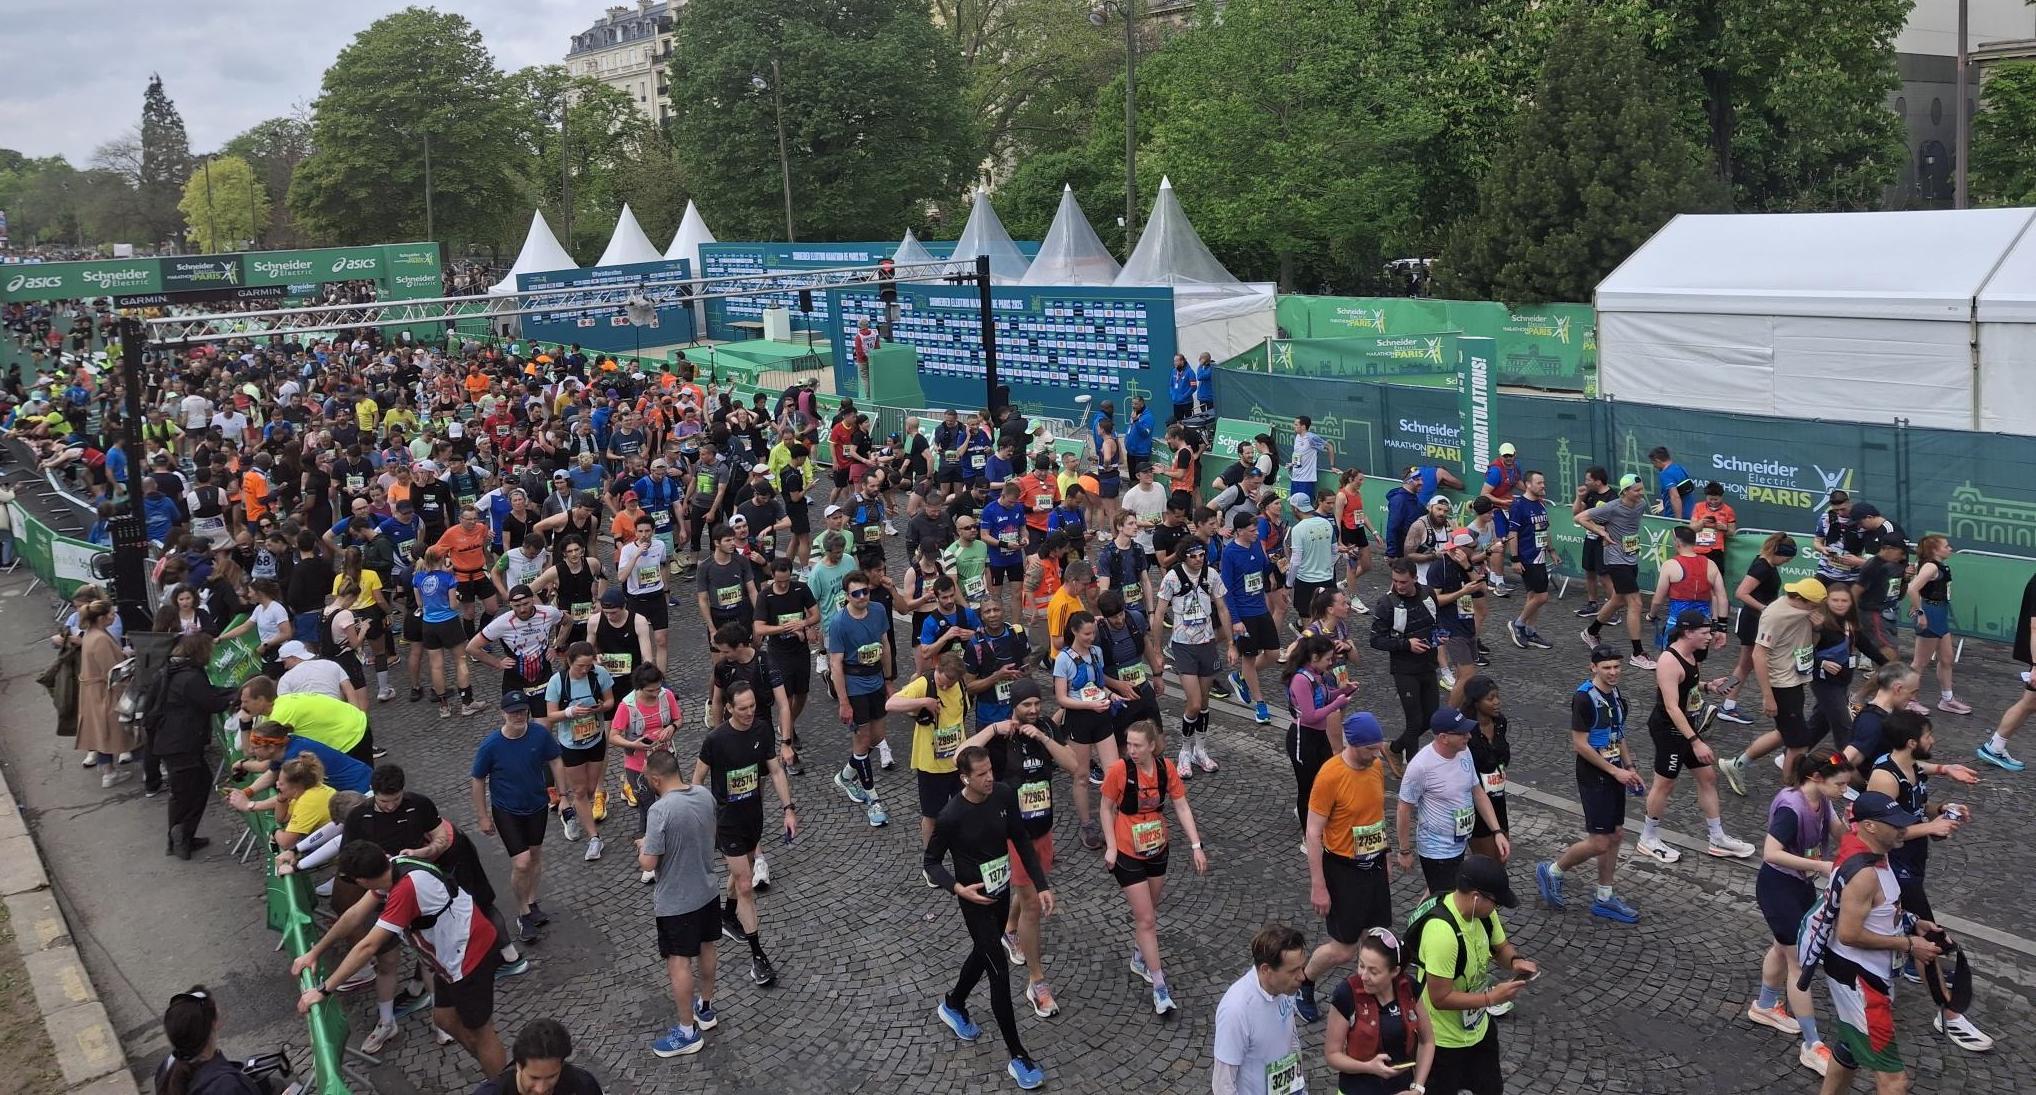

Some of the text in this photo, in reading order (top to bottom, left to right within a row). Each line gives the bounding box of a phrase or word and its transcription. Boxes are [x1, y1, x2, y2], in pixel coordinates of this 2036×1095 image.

[176, 263, 215, 271] Schneider
[254, 260, 313, 274] Schneider
[346, 258, 376, 270] asics
[82, 269, 149, 282] Schneider
[25, 276, 62, 289] asics
[237, 288, 281, 297] GARMIN
[120, 295, 167, 306] GARMIN
[1350, 319, 1372, 328] PARIS
[1528, 327, 1552, 336] PARIS
[1376, 339, 1417, 347] Schneider
[1394, 350, 1424, 359] PARIS
[1471, 356, 1489, 473] CONGRATULATIONS!
[1400, 419, 1460, 437] Schneider
[1384, 438, 1426, 452] MARATHON
[1425, 434, 1459, 446] Electric
[1426, 444, 1460, 462] PARI
[1712, 453, 1799, 478] Schneider
[1748, 473, 1797, 488] Electric
[1739, 486, 1812, 508] DE PARIS
[257, 556, 270, 566] 68
[1781, 566, 1817, 576] MARATH
[732, 775, 754, 788] 32574
[1025, 789, 1046, 804] 72963
[1359, 833, 1383, 848] 27556
